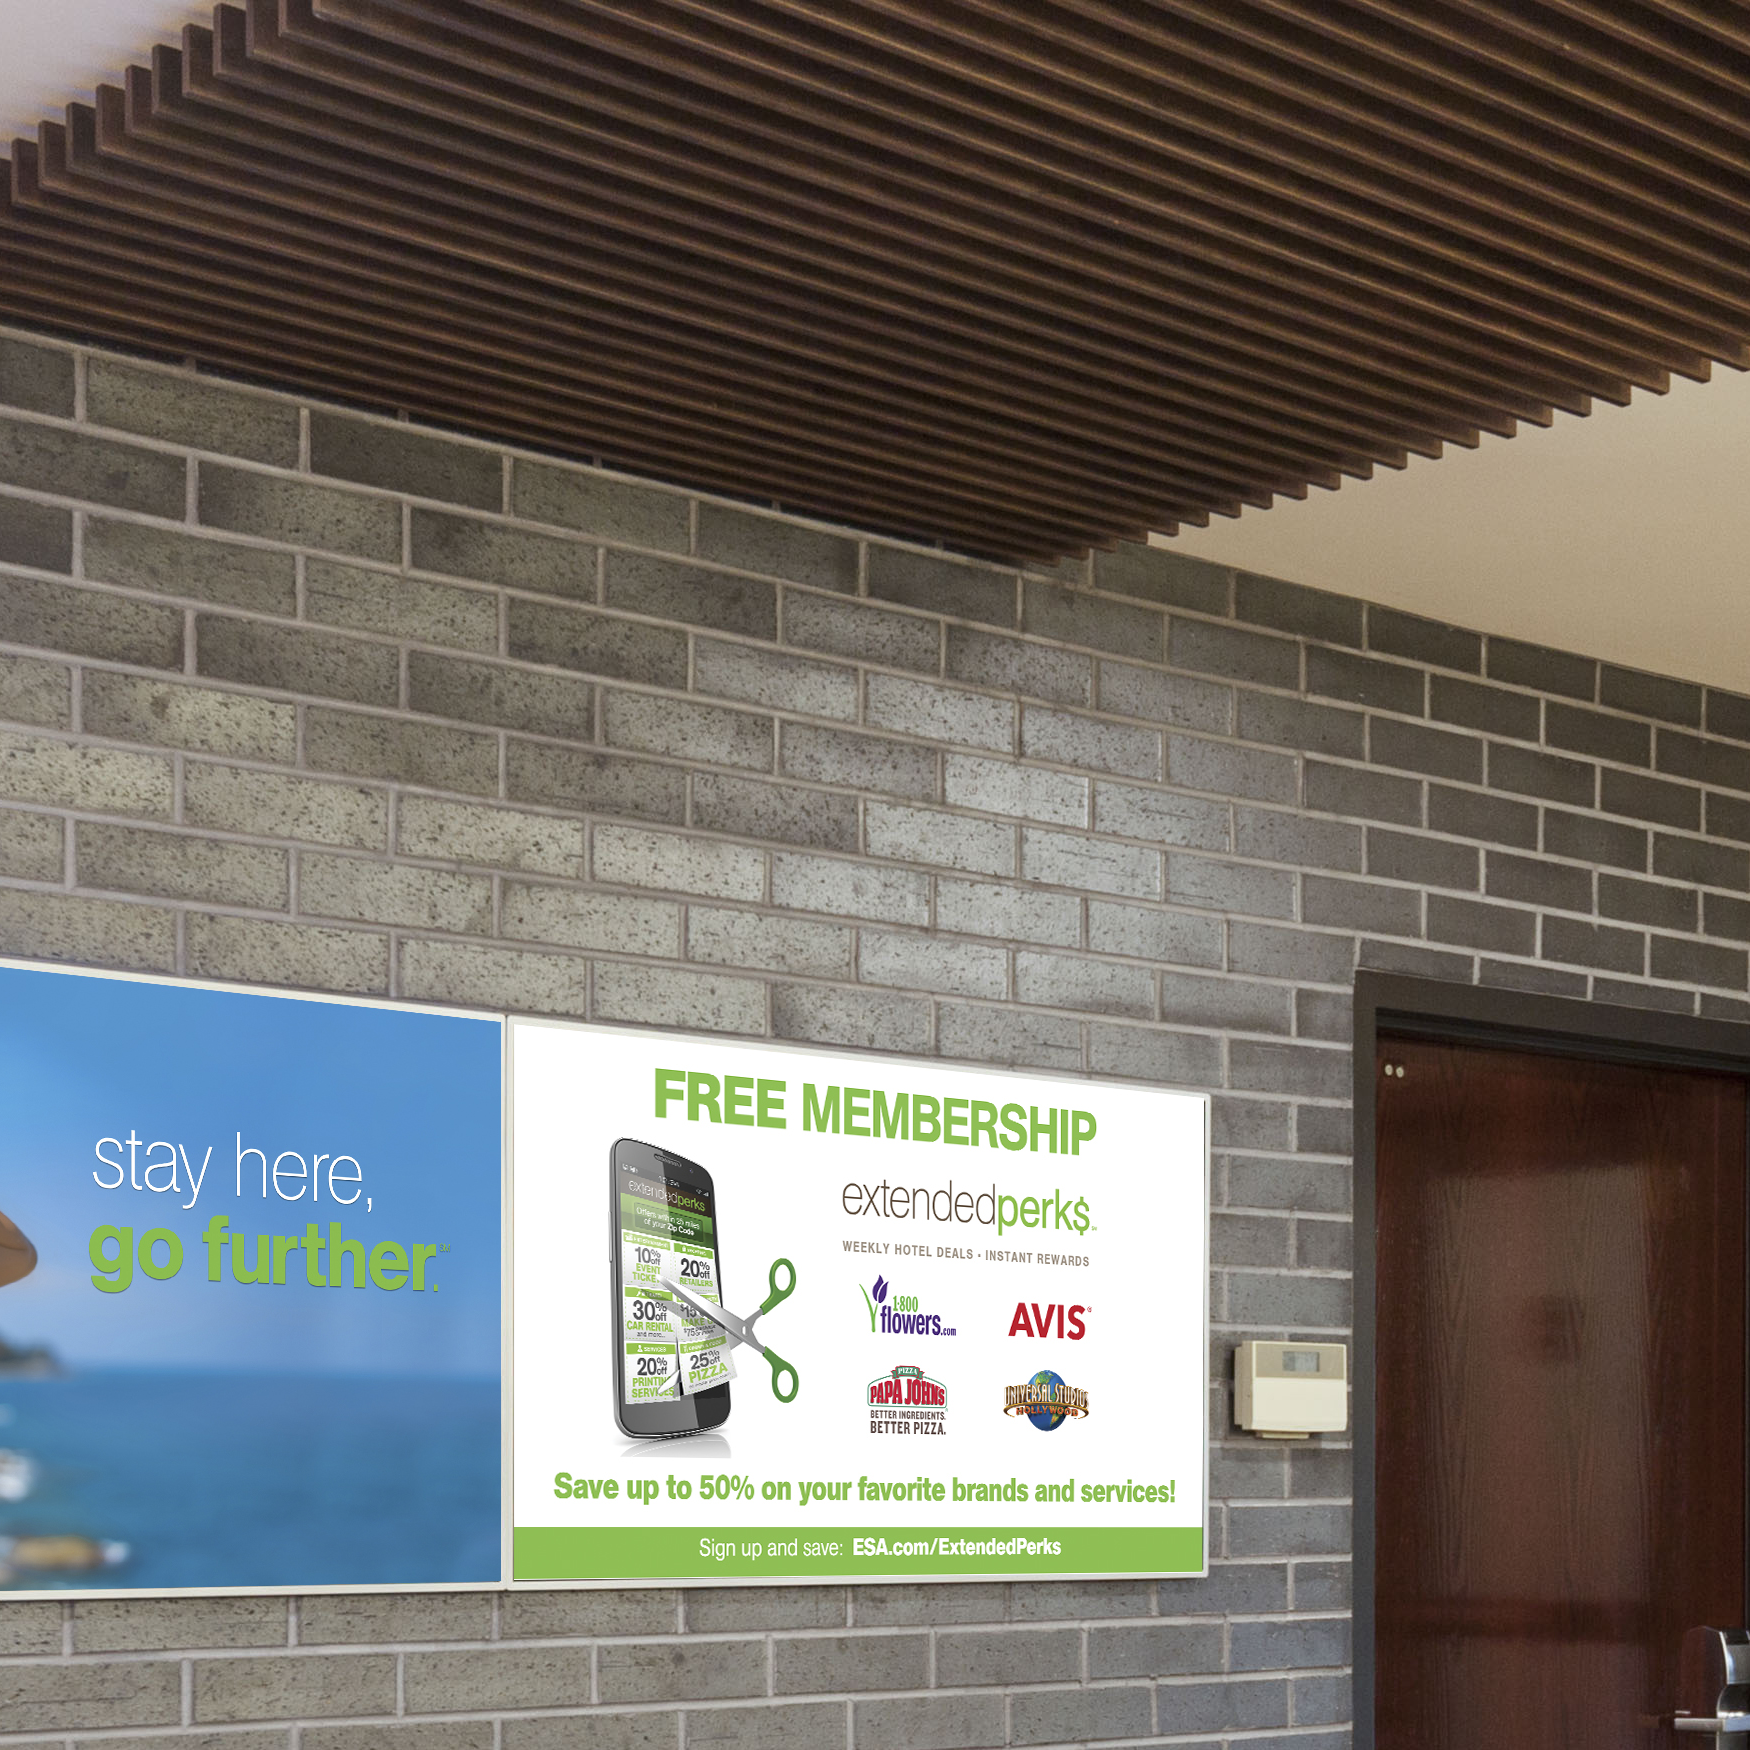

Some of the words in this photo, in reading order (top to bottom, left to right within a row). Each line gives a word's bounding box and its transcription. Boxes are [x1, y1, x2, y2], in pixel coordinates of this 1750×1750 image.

[655, 1068, 786, 1129] FREE
[803, 1083, 1097, 1156] MEMBERSHIP
[93, 1129, 213, 1210] stay
[235, 1131, 373, 1213] here,
[628, 1180, 705, 1212] extendedperks
[88, 1224, 184, 1293] go
[635, 1247, 661, 1263] 10%
[842, 1240, 890, 1255] WEEKLY
[895, 1244, 932, 1257] HOTEL
[937, 1247, 973, 1260] DEALS
[985, 1250, 1033, 1264] INSTANT
[1037, 1253, 1090, 1267] REWARDS
[636, 1263, 661, 1275] EVENT
[681, 1258, 710, 1278] 20%
[699, 1271, 710, 1280] off
[679, 1277, 713, 1287] RETAILERS
[633, 1300, 667, 1320] 30%
[655, 1312, 667, 1321] off
[626, 1320, 643, 1331] CAR
[646, 1322, 673, 1333] RENTAL
[880, 1305, 957, 1336] flowers.com
[1008, 1302, 1086, 1340] AVIS
[637, 1357, 667, 1376] 20%
[690, 1350, 720, 1370] 25%
[709, 1356, 720, 1365] off
[656, 1366, 667, 1375] off
[688, 1363, 728, 1383] PIZZA
[897, 1367, 918, 1375] PIZZA
[870, 1379, 903, 1404] PAPA
[1004, 1383, 1052, 1406] UNIVERSAL
[870, 1409, 897, 1419] BETTER
[1016, 1405, 1079, 1417] HOLLYWOOD
[870, 1420, 911, 1434] BETTER
[914, 1421, 947, 1435] PIZZA.
[554, 1472, 619, 1499] Save
[627, 1480, 660, 1505] up
[666, 1475, 692, 1500] to
[699, 1474, 754, 1500] 50%
[762, 1481, 792, 1500] on
[798, 1481, 852, 1506] your
[858, 1476, 946, 1501] favorite
[952, 1477, 1029, 1502] brands
[1035, 1479, 1075, 1502] and
[1080, 1479, 1176, 1503] services!
[699, 1538, 736, 1561] Sign
[742, 1543, 762, 1561] up
[767, 1538, 798, 1557] and
[802, 1543, 844, 1556] save:
[853, 1537, 1062, 1557] ESA.com/ExtendedPerks
